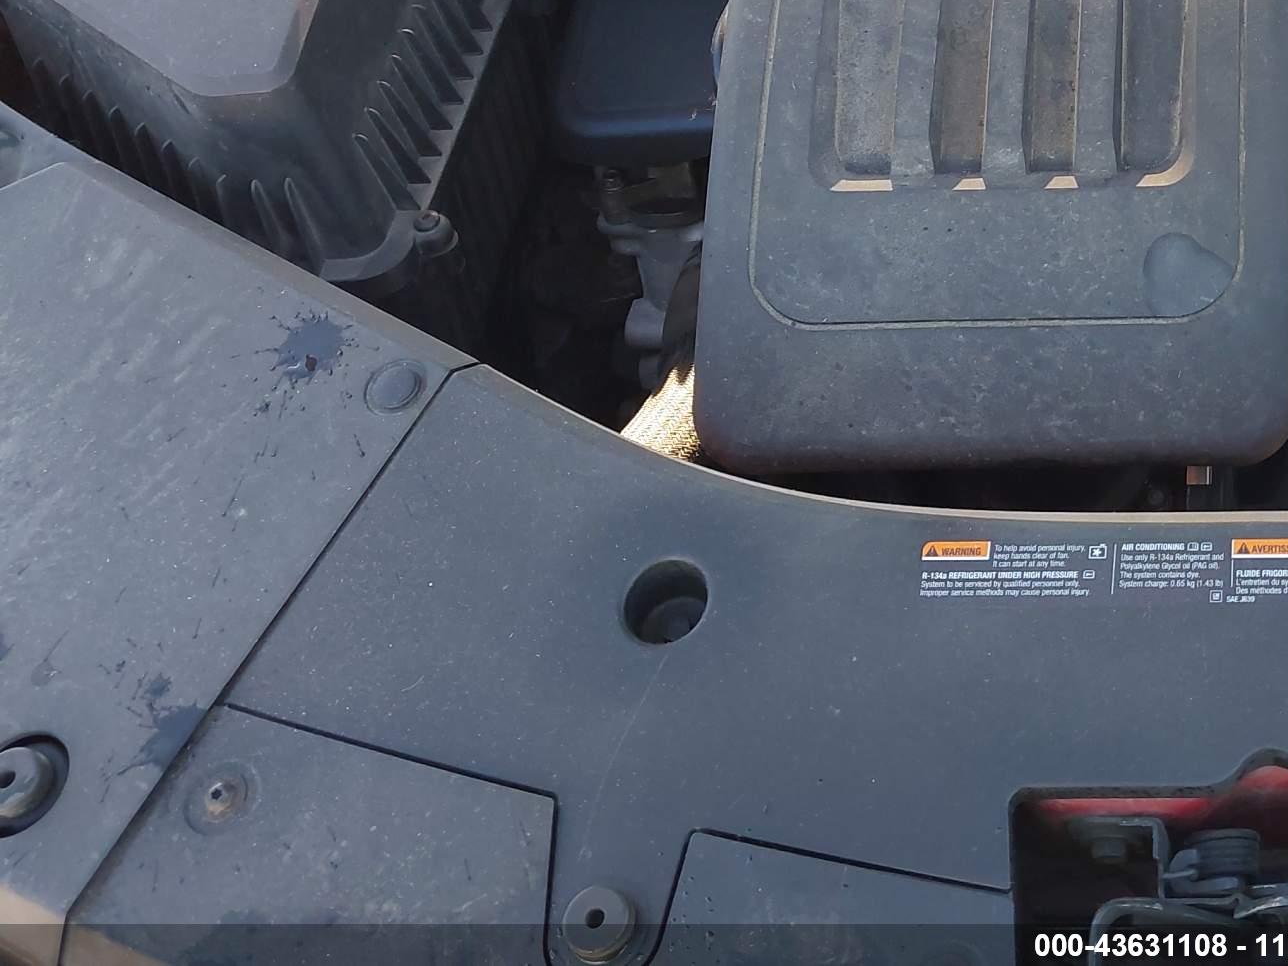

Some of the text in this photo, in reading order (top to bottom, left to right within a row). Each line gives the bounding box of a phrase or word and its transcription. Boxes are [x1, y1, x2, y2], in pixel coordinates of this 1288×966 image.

[1121, 543, 1185, 551] AIR CONDITIONING
[941, 547, 982, 556] WARNING
[948, 571, 996, 579] REFRIGERANT
[998, 571, 1022, 579] UNDER
[1023, 571, 1041, 579] HIGH
[1042, 571, 1079, 579] PRESSURE
[1236, 569, 1260, 577] FLUIDE
